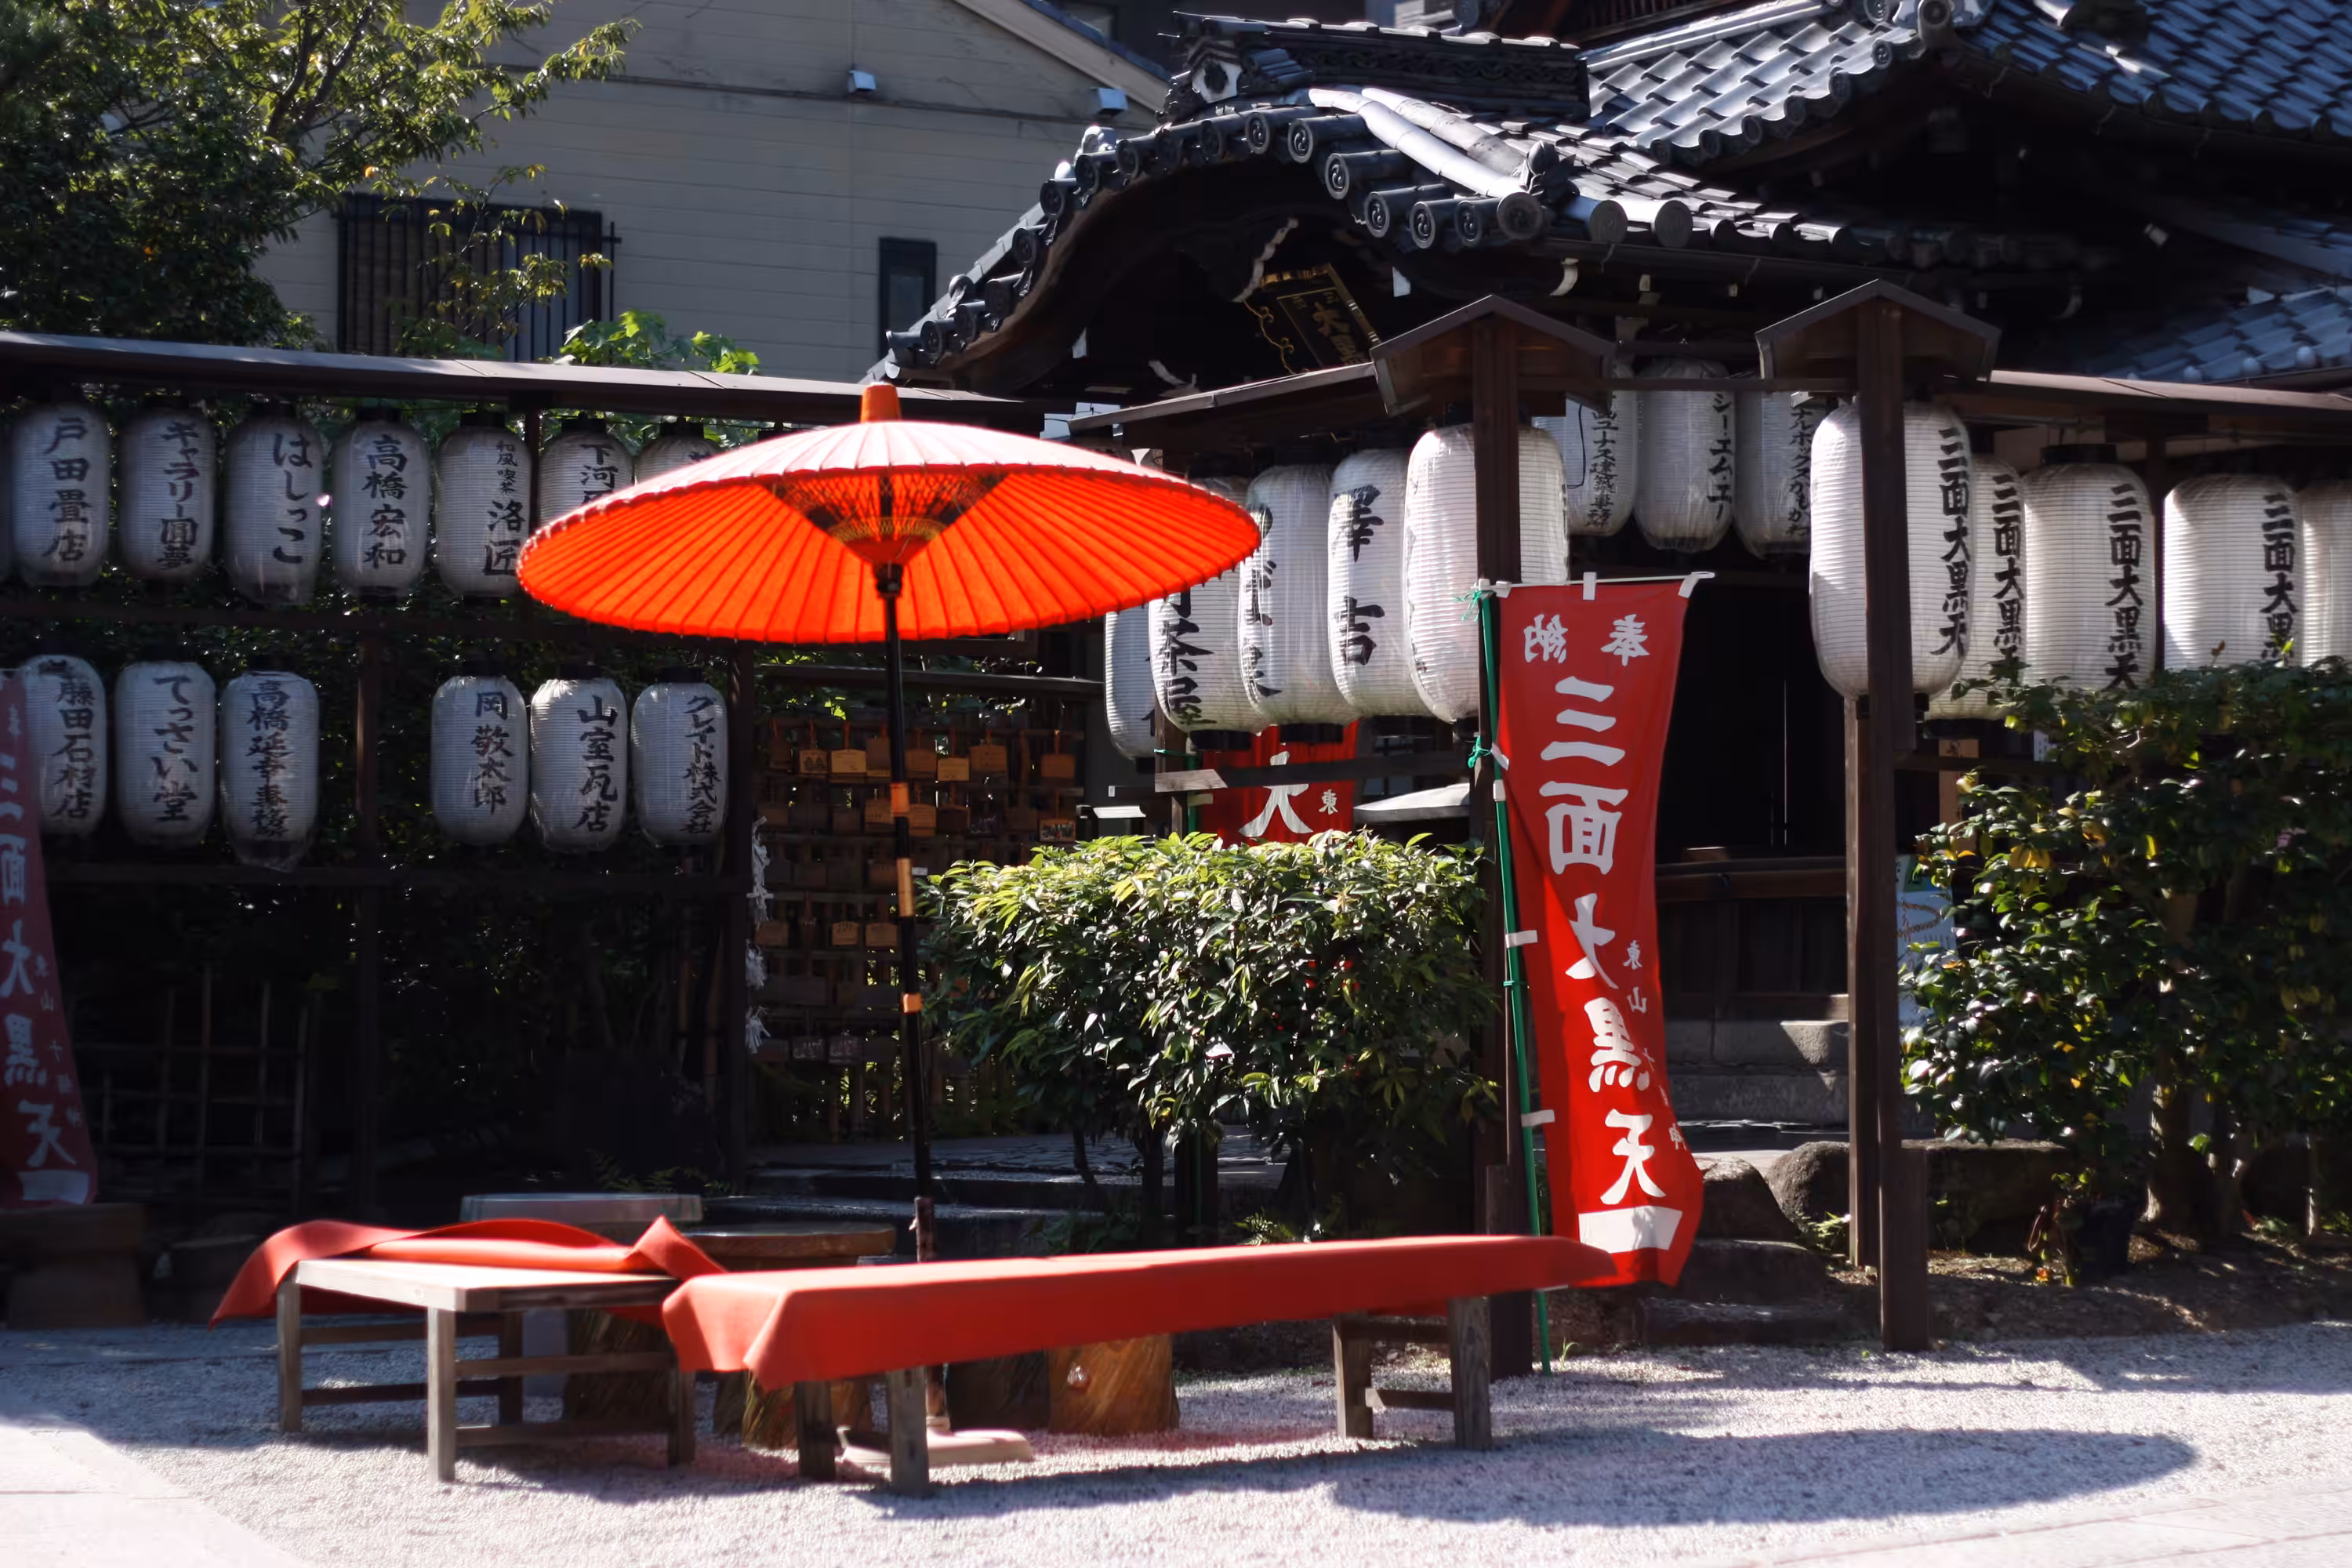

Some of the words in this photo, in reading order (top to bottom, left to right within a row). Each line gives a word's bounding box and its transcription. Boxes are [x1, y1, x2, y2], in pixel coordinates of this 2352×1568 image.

[43, 416, 93, 562] 戸田畳店
[272, 432, 314, 564] はしっこ
[359, 434, 408, 571] 高橋宏和
[1930, 428, 1971, 657] 三面大黒天
[2105, 484, 2143, 691] 三面大黒天
[51, 673, 96, 818] 藤田石材店
[150, 674, 200, 822] てっさい堂
[471, 691, 515, 815] 岡敬太郎
[572, 695, 619, 833] 山室瓦店
[681, 695, 722, 835] グレイド株式会社
